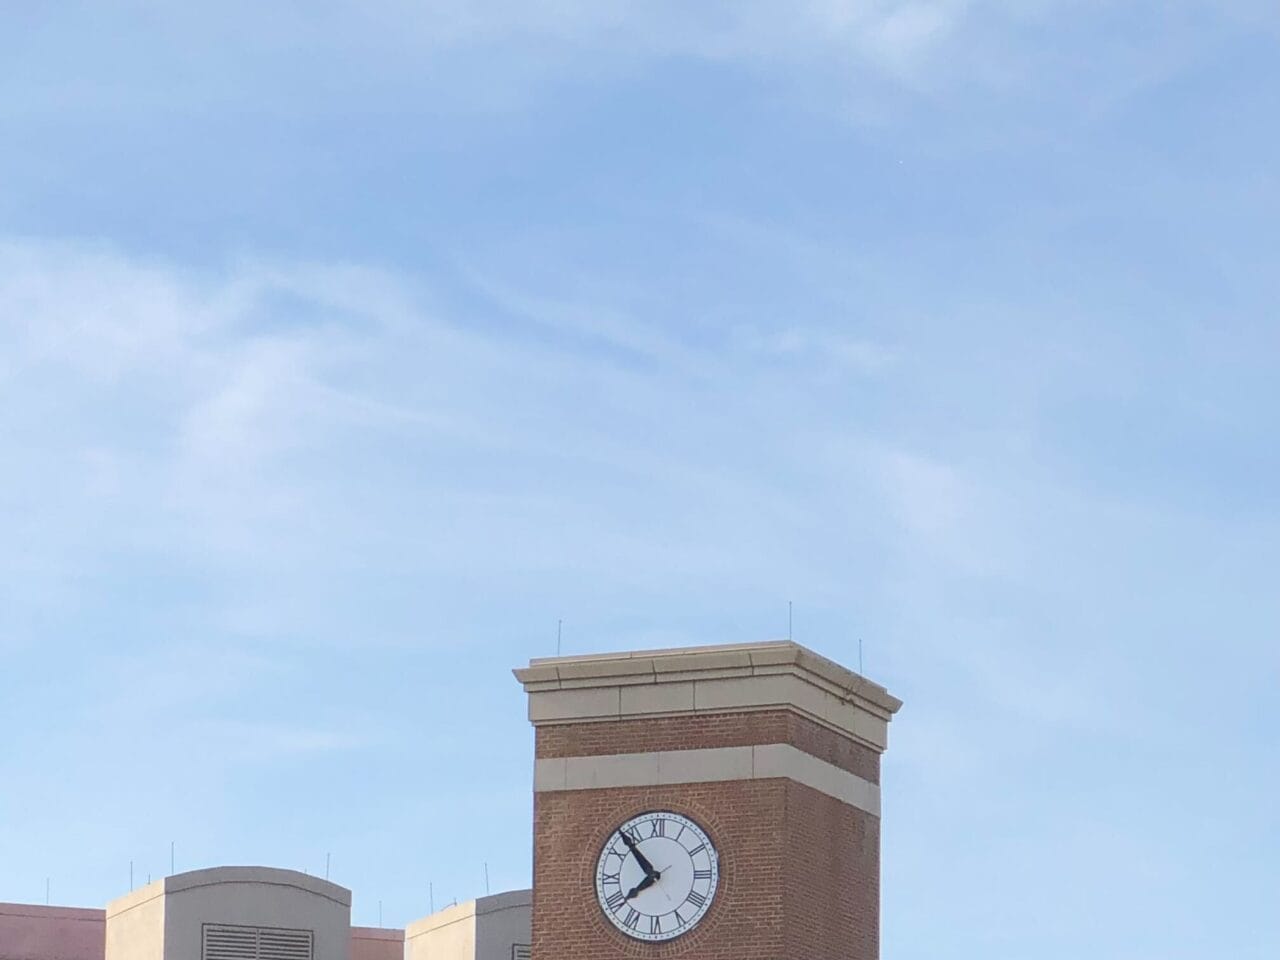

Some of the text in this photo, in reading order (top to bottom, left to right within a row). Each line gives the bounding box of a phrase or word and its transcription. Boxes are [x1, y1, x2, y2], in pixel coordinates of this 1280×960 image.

[651, 819, 665, 837] XII
[609, 848, 626, 861] X
[689, 844, 706, 857] II
[603, 873, 620, 884] IX
[694, 869, 712, 880] III
[675, 911, 686, 928] V
